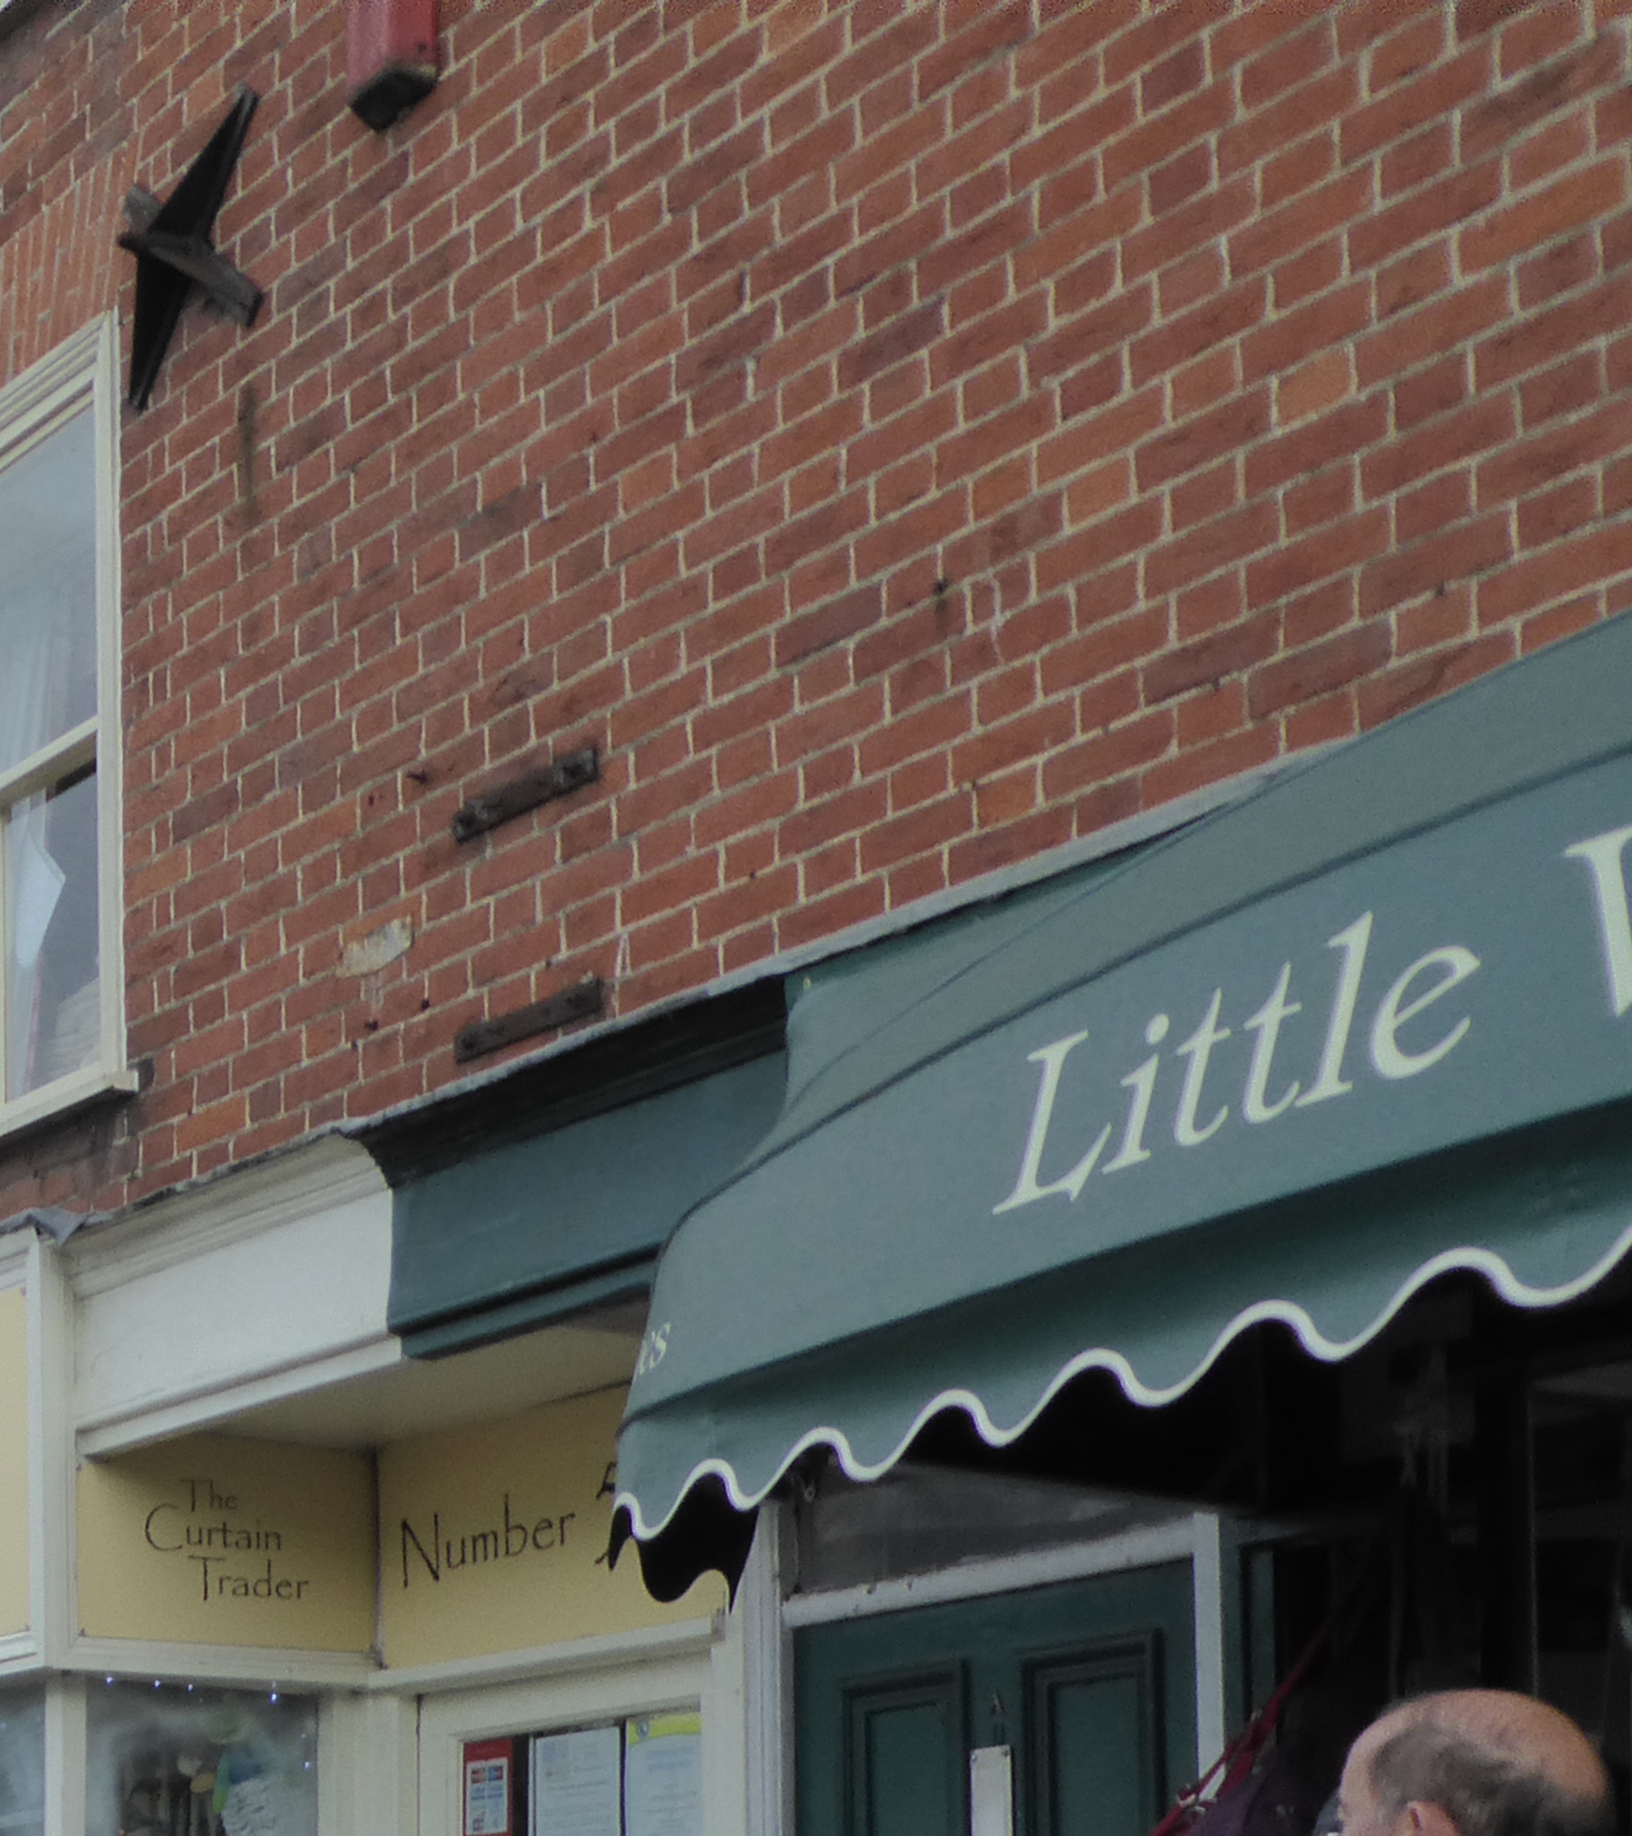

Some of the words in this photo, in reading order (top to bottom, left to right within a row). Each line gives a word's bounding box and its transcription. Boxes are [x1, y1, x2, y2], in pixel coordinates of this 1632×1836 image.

[992, 910, 1481, 1216] Little
[179, 1478, 238, 1513] The
[144, 1503, 282, 1552] Curtain
[400, 1494, 576, 1589] Number
[188, 1553, 310, 1602] Trader
